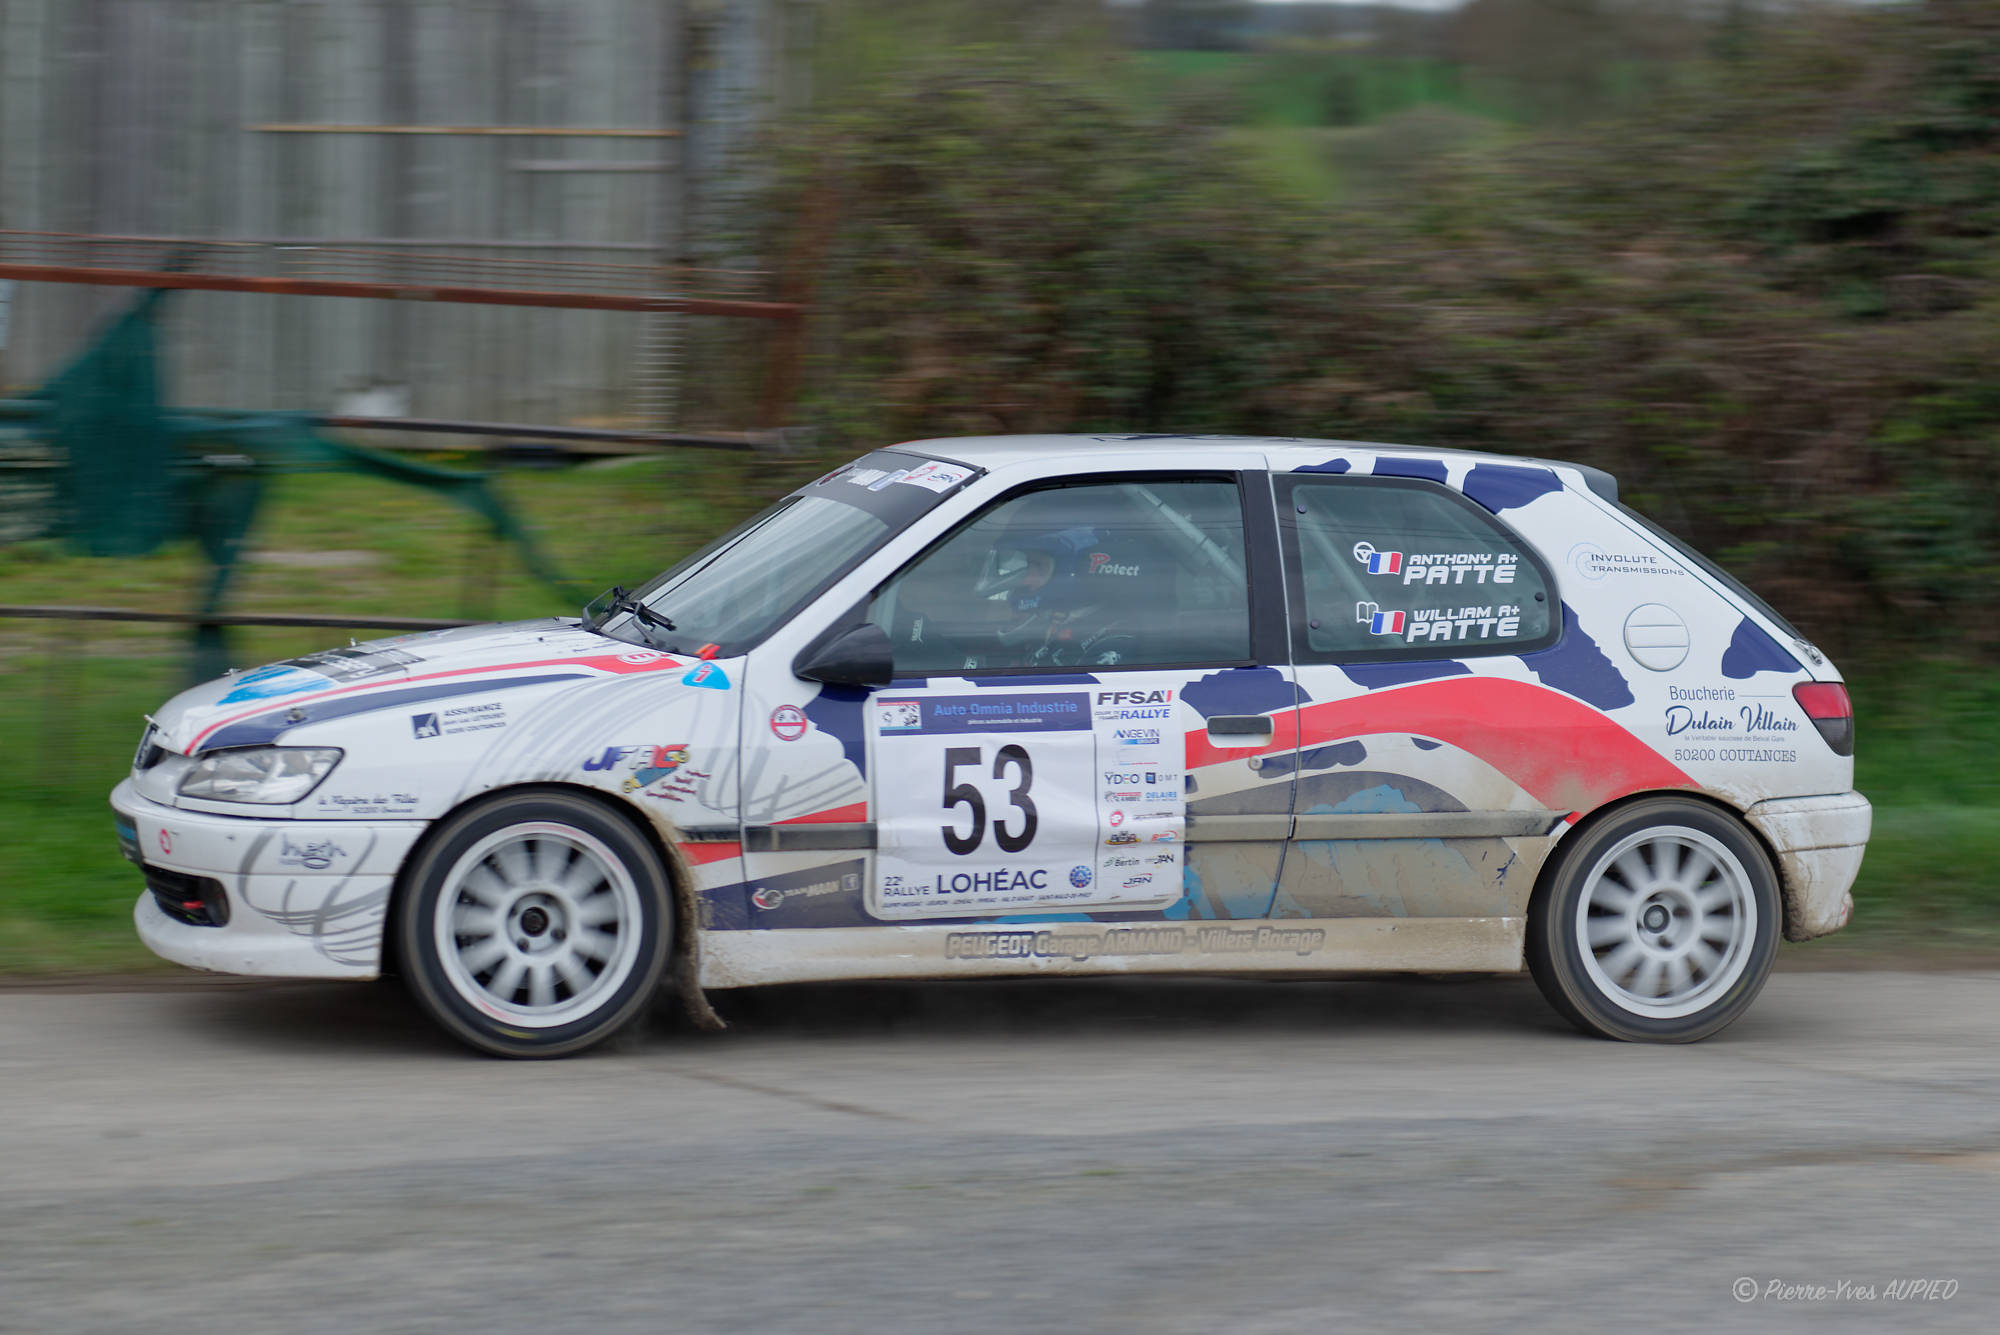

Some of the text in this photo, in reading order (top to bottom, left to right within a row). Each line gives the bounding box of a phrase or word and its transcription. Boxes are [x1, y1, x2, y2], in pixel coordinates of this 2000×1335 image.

[1089, 553, 1140, 577] Protect
[1408, 554, 1519, 566] ANTHONY A+
[1591, 553, 1657, 564] INVOLUTE
[1403, 564, 1518, 585] PATTE
[1591, 564, 1685, 576] TRANSMISSIONS
[1413, 605, 1520, 622] WILLIAM A+
[1406, 616, 1520, 643] PATTE
[1097, 690, 1165, 706] FFSA
[1669, 685, 1735, 701] Boucherie
[934, 700, 1079, 716] Auto Omnia Industrie
[1120, 709, 1170, 720] RALLYE
[1665, 703, 1799, 736] Dulain Villain
[1112, 729, 1160, 738] ANGEVIN
[1675, 749, 1797, 762] 50200 COUTANCES
[941, 744, 1038, 855] 53
[937, 868, 1048, 894] LOHÉAC
[884, 885, 930, 897] RALLYE
[947, 933, 1033, 958] PEUGEOT
[1035, 932, 1097, 960] Garage
[1103, 930, 1183, 955] ARMAND
[1200, 930, 1253, 953] Villers
[1256, 927, 1325, 954] Bocage
